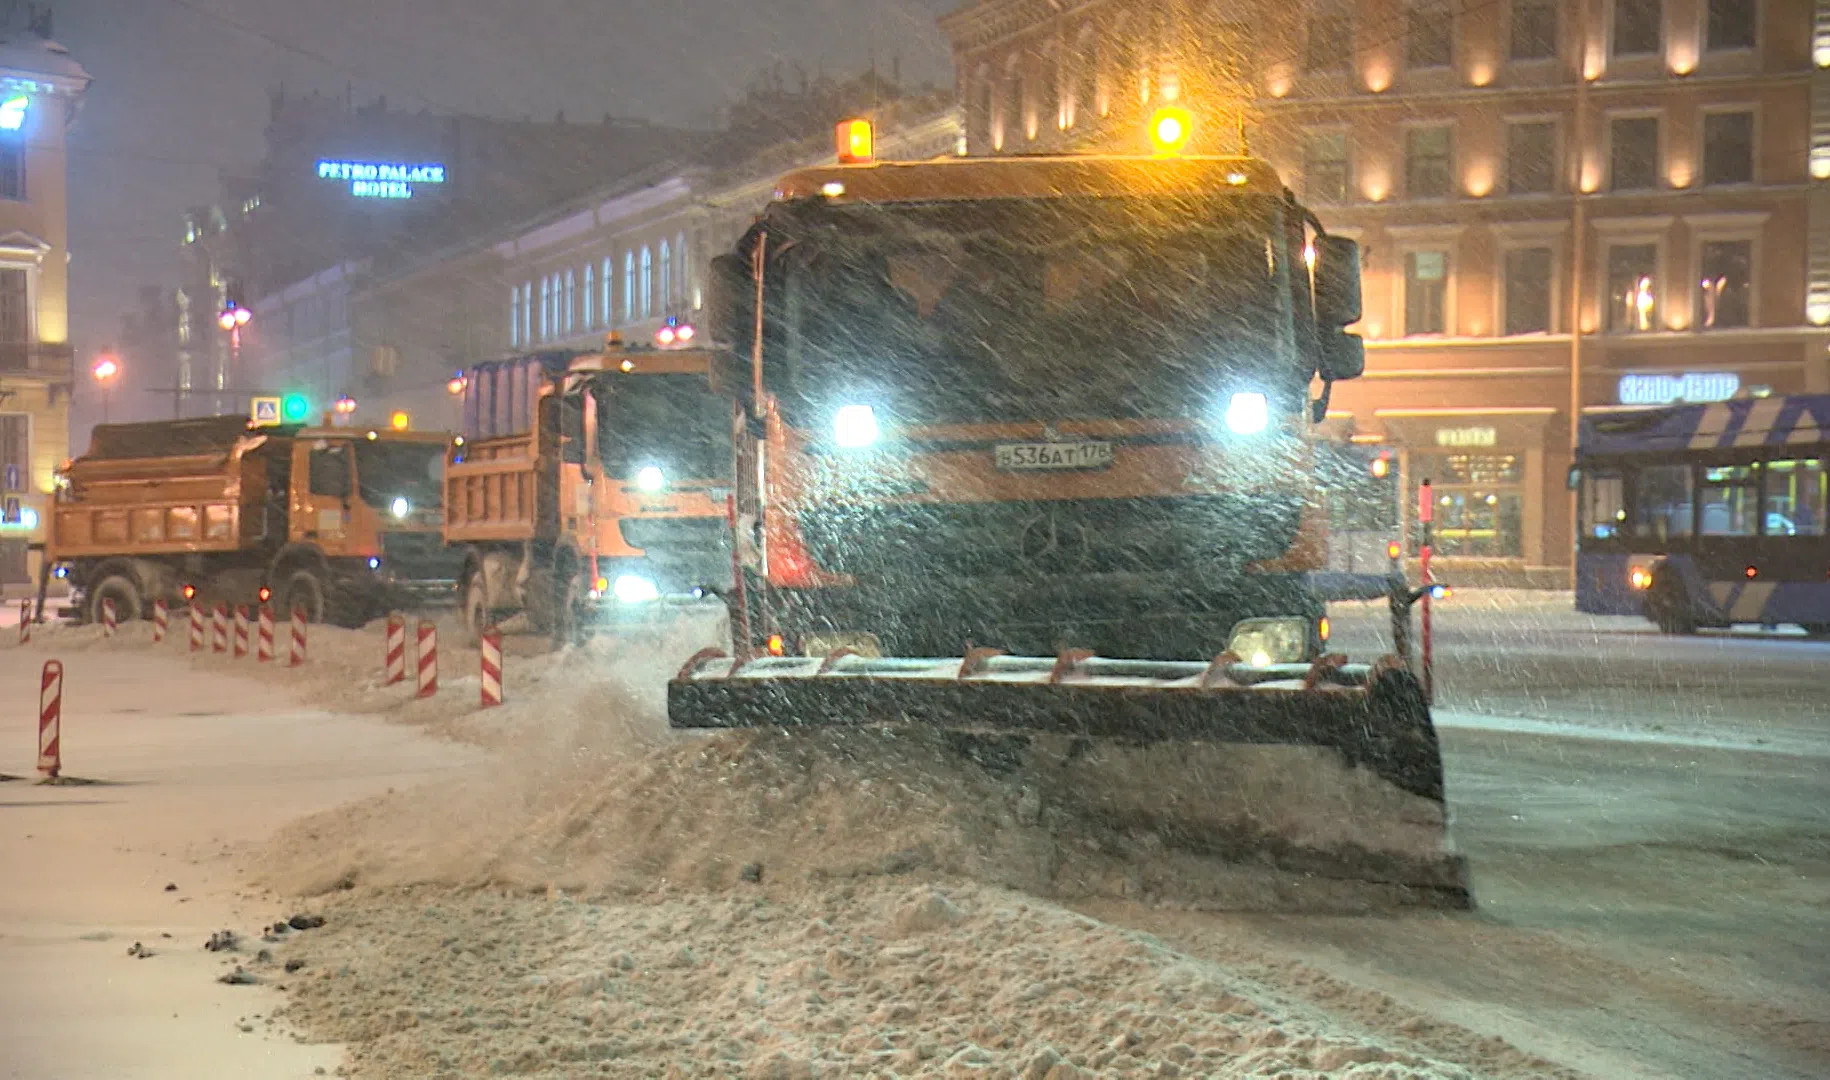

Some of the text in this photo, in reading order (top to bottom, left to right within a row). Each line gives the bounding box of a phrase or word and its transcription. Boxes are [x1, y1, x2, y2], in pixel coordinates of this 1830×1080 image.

[318, 161, 444, 183] PETRO PALACE
[352, 180, 412, 199] HOTEL
